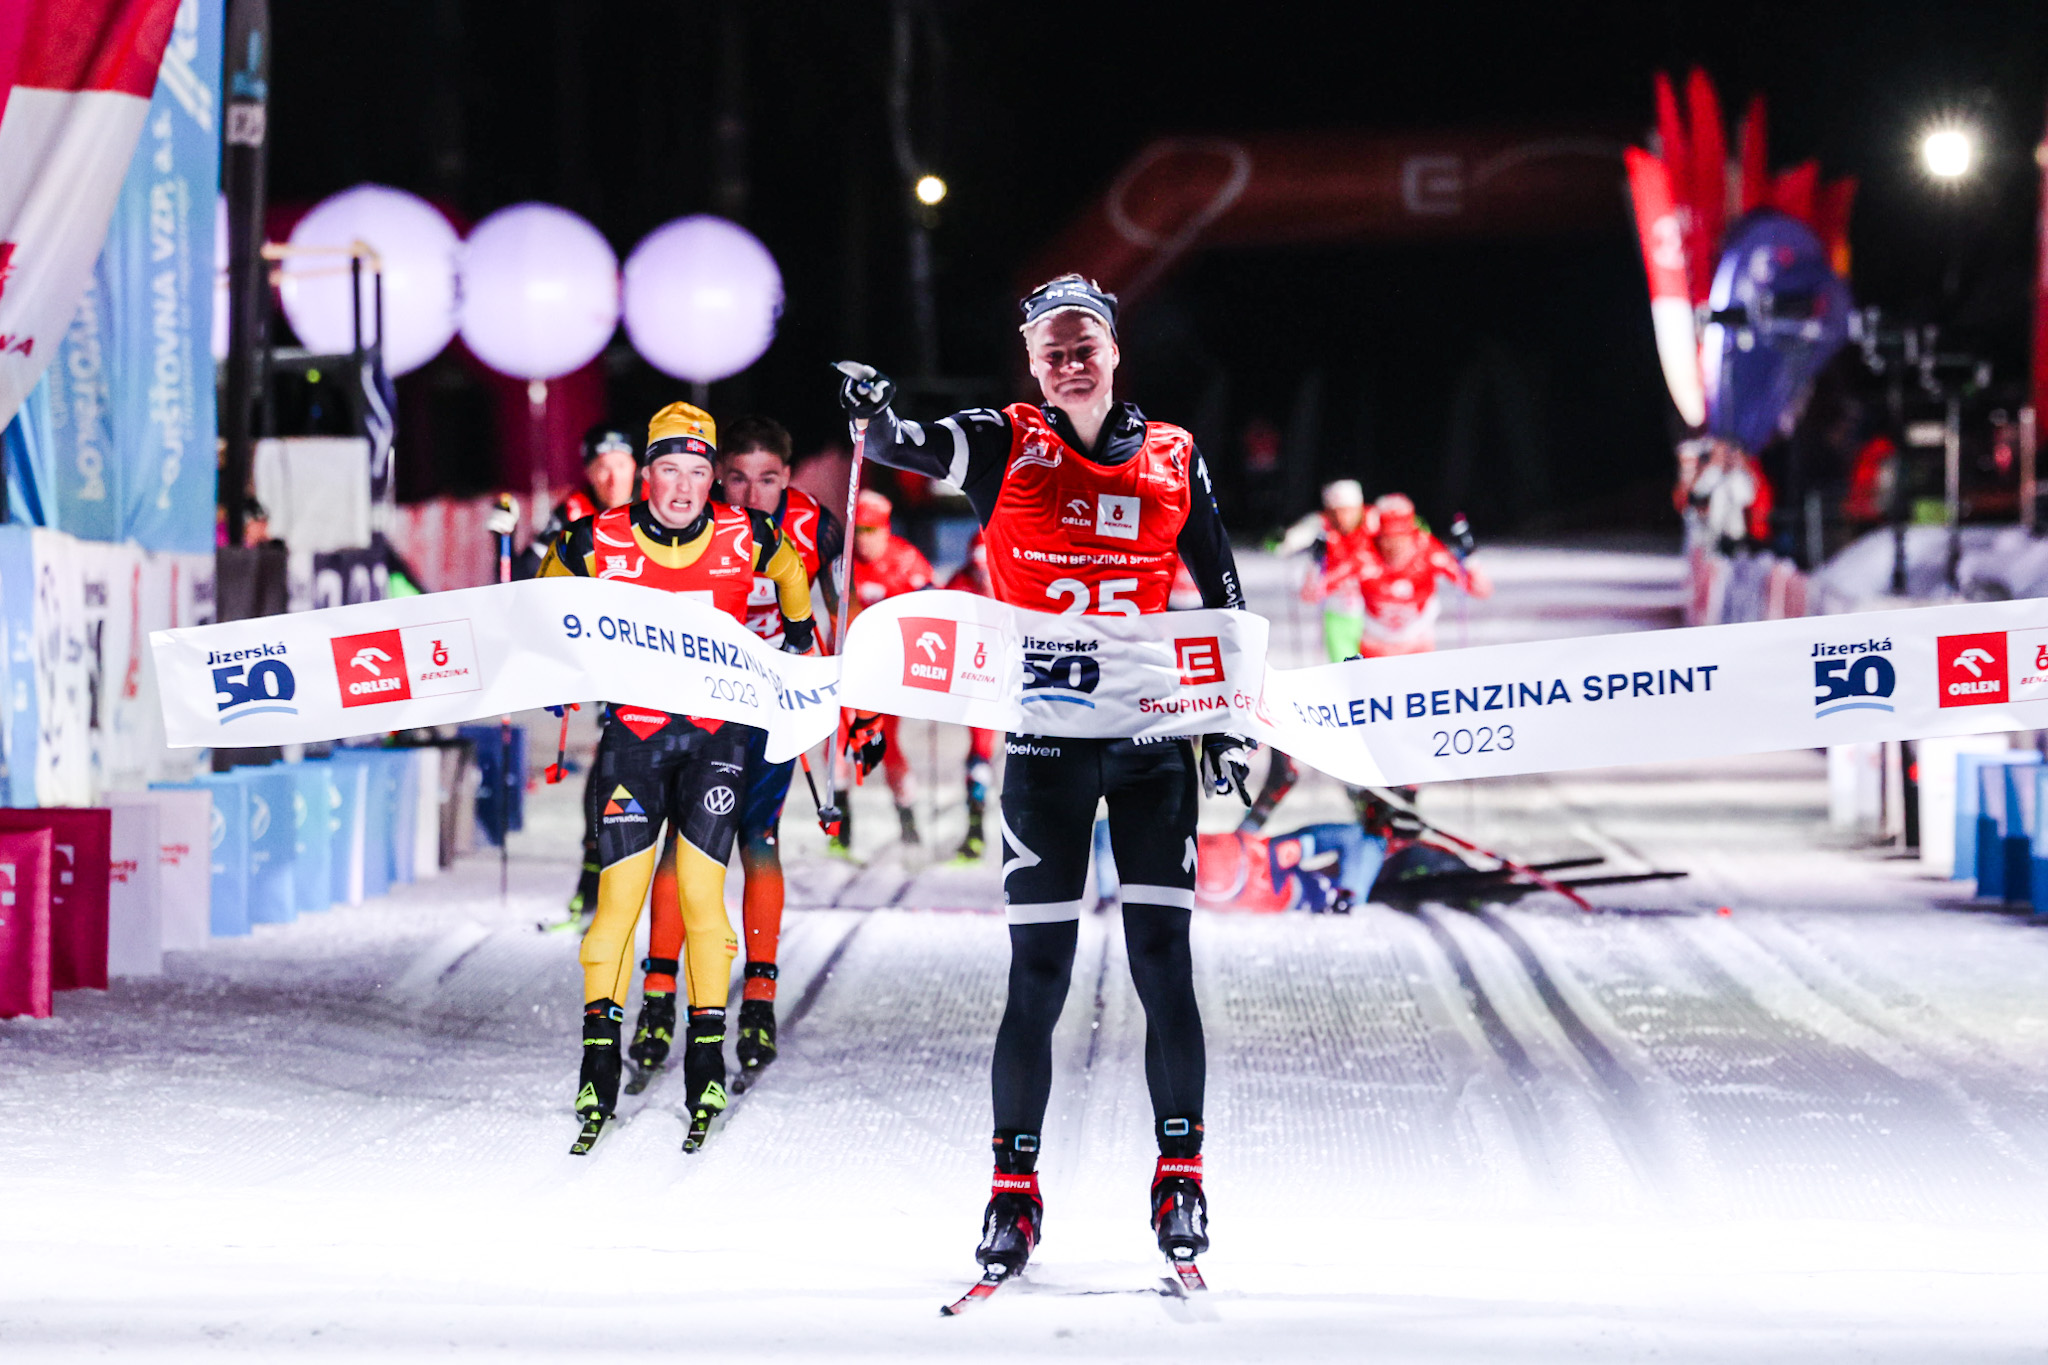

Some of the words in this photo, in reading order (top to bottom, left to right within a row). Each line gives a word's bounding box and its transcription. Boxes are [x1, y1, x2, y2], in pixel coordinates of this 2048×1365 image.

[1062, 516, 1092, 527] ORLEN
[1012, 547, 1023, 559] 9.
[1024, 551, 1067, 564] ORLEN
[1069, 554, 1127, 565] BENZINA
[1045, 578, 1142, 617] 25
[563, 614, 592, 639] 9.
[598, 616, 677, 655] ORLEN
[1022, 636, 1099, 652] Jizerská
[206, 641, 288, 665] Jizerská
[1811, 637, 1893, 657] Jizerská
[420, 668, 470, 681] BENZINA
[911, 663, 948, 681] ORLEN
[960, 671, 996, 684] BENZINA
[1021, 653, 1101, 695] 50
[1814, 655, 1897, 706] 50
[212, 659, 296, 712] 50
[348, 677, 402, 696] ORLEN
[704, 676, 759, 708] 2023
[1948, 680, 2001, 696] ORLEN
[1138, 695, 1230, 714] SKUPINA
[1307, 695, 1393, 728] ORLEN
[1406, 679, 1572, 719] BENZINA
[1582, 665, 1720, 702] SPRINT
[1432, 725, 1516, 758] 2023
[602, 814, 649, 825] Ramudden
[694, 1034, 725, 1044] FISCH
